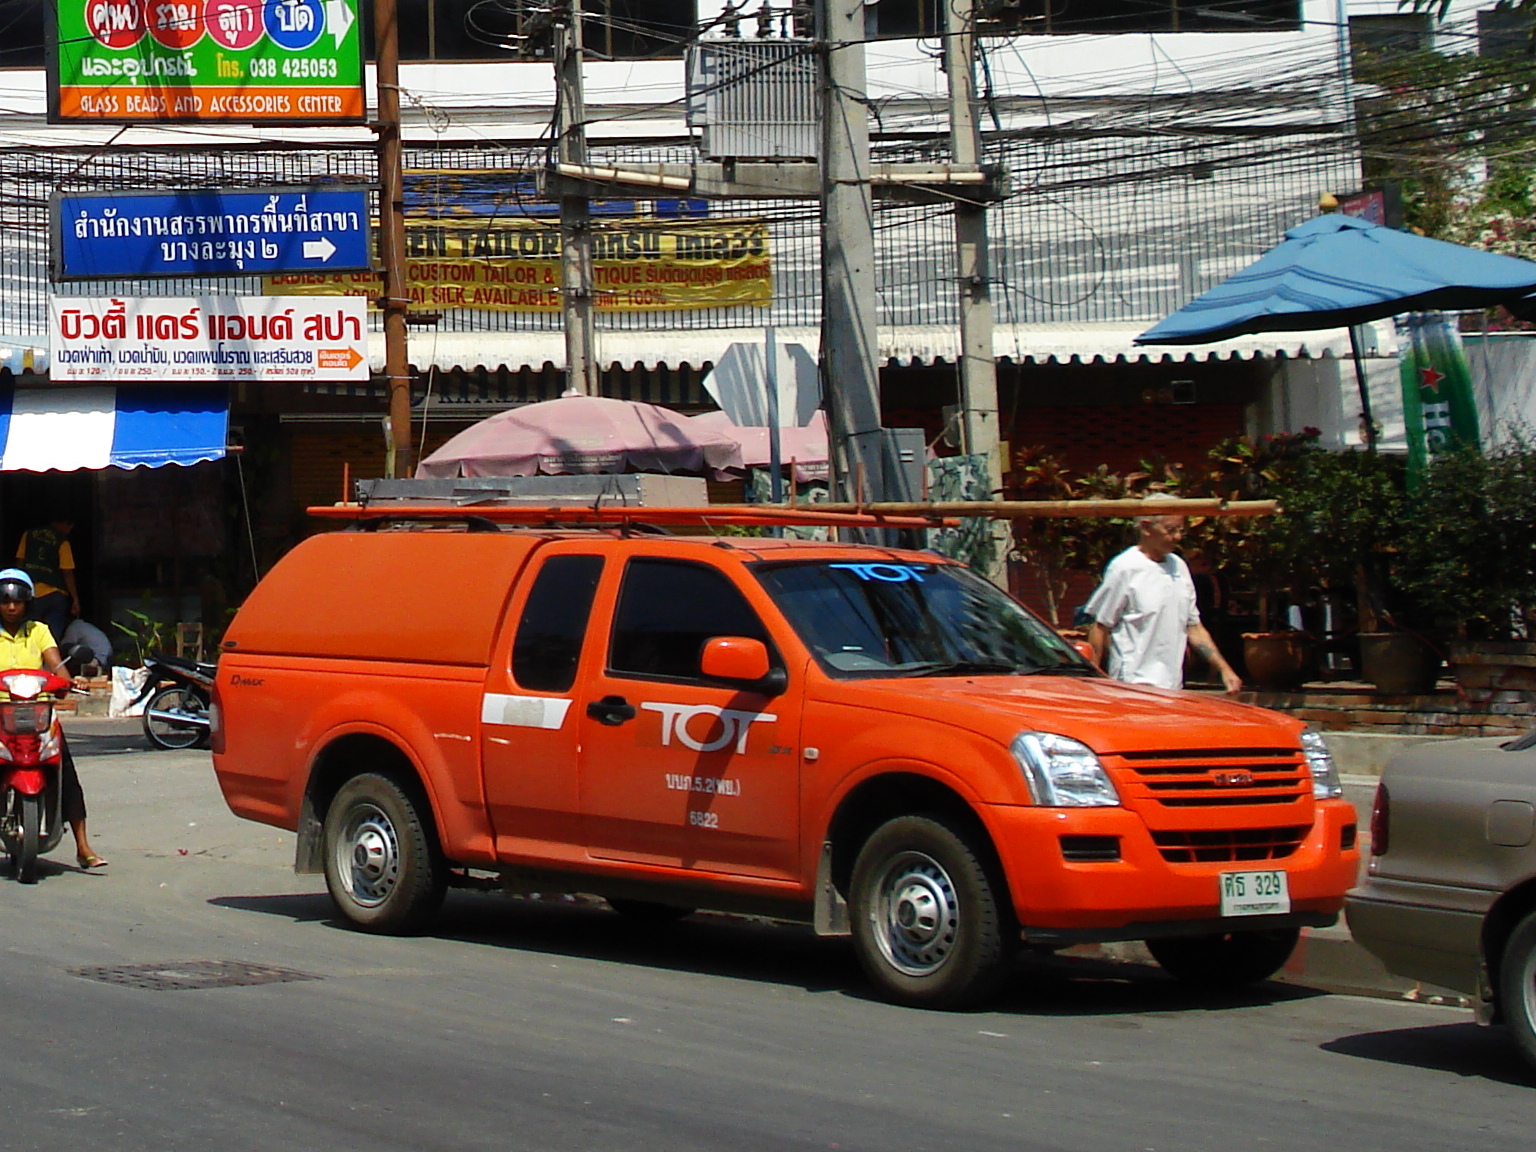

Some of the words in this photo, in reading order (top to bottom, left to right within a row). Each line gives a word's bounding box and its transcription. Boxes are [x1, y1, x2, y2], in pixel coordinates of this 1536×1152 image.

[158, 4, 197, 31] รวม
[218, 4, 254, 45] ลูก
[250, 59, 277, 78] 038
[282, 58, 338, 78] 425053
[80, 95, 119, 113] GLASS
[126, 95, 166, 113] BEADS
[175, 96, 203, 113] AND
[210, 95, 291, 113] ACCESSORIES
[298, 96, 342, 114] CENTER
[74, 195, 359, 239] สำนักงานสรรพากรพื้นที่สาขา
[161, 238, 255, 270] บางละมุง
[261, 238, 279, 259] ๒
[463, 229, 562, 259] TAILOR
[409, 264, 475, 282] CUSTOM
[482, 265, 537, 283] TAILOR
[544, 267, 555, 284] &
[432, 287, 465, 304] SILK
[473, 288, 558, 306] AVAILABLE
[61, 298, 126, 340] บิวตี้
[137, 307, 201, 340] แคร์
[208, 308, 295, 340] แอนด์
[303, 310, 361, 341] สปา
[829, 563, 927, 583] TOT
[640, 701, 778, 754] TOT
[690, 811, 719, 829] 6822
[1255, 873, 1281, 896] 329
